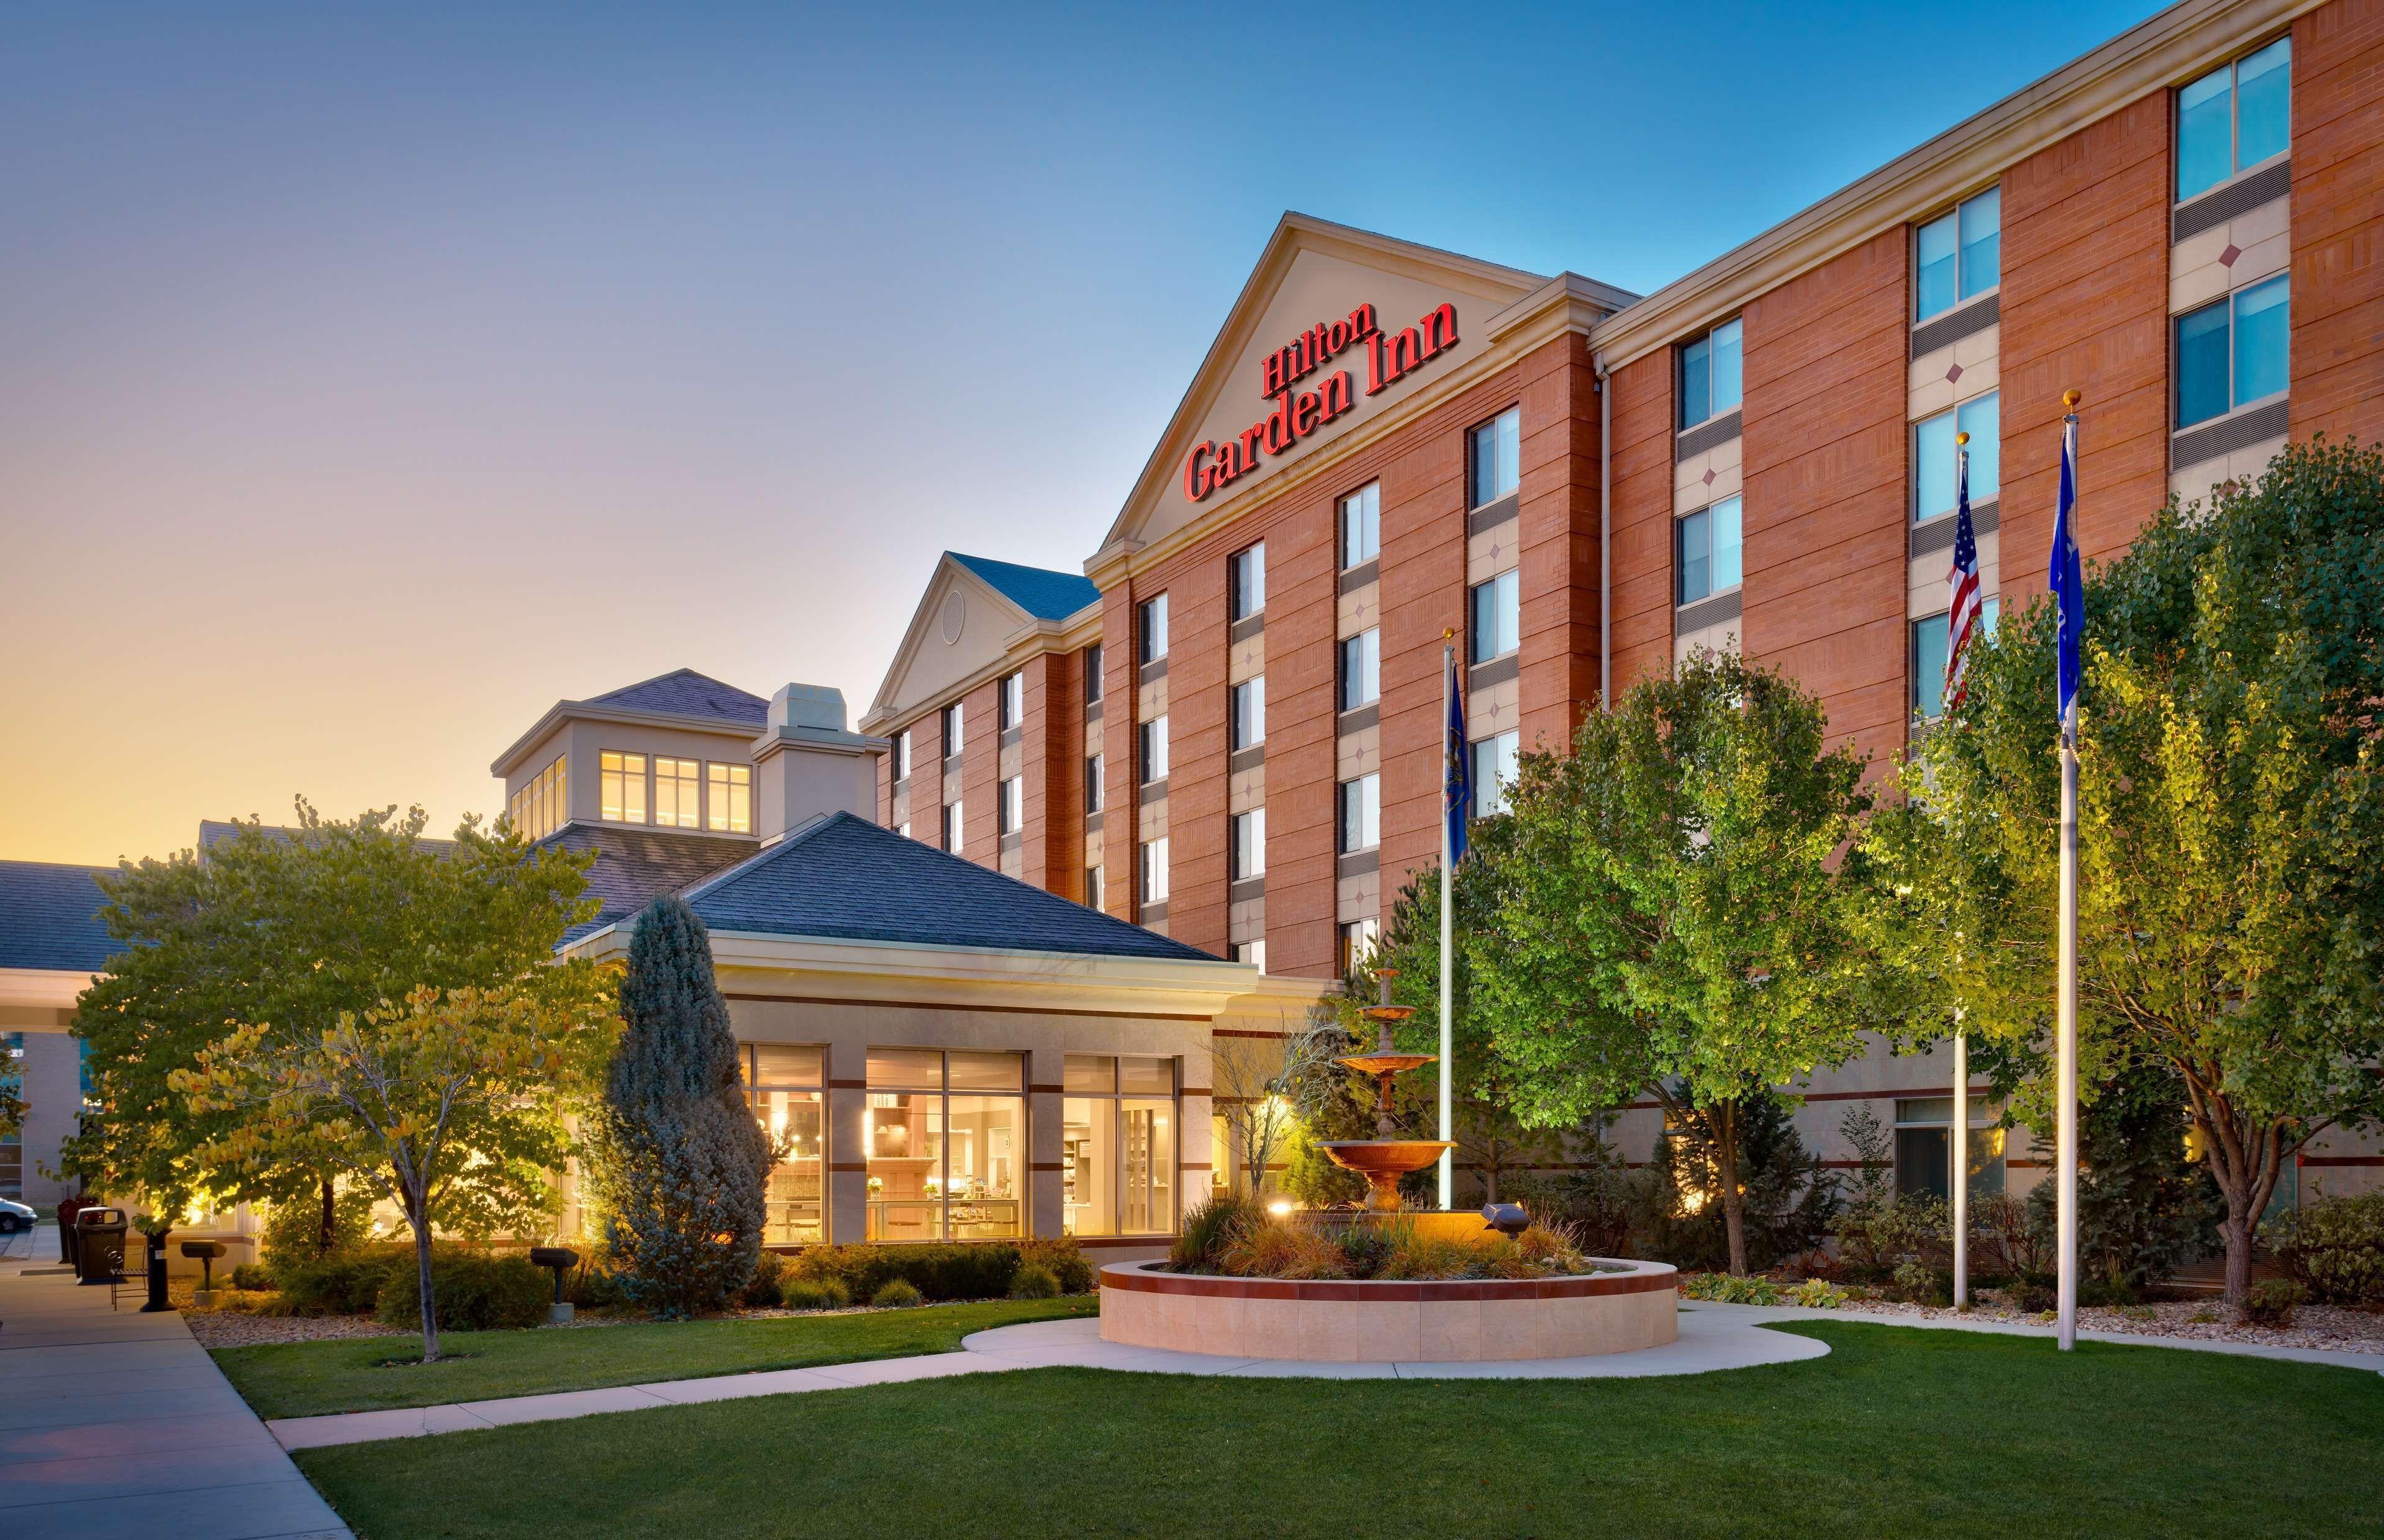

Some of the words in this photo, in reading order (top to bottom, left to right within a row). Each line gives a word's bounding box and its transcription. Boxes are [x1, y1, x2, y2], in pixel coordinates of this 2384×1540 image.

[1184, 370, 1353, 502] Garden
[1364, 302, 1459, 397] Inn
[1261, 302, 1377, 399] Hilton
